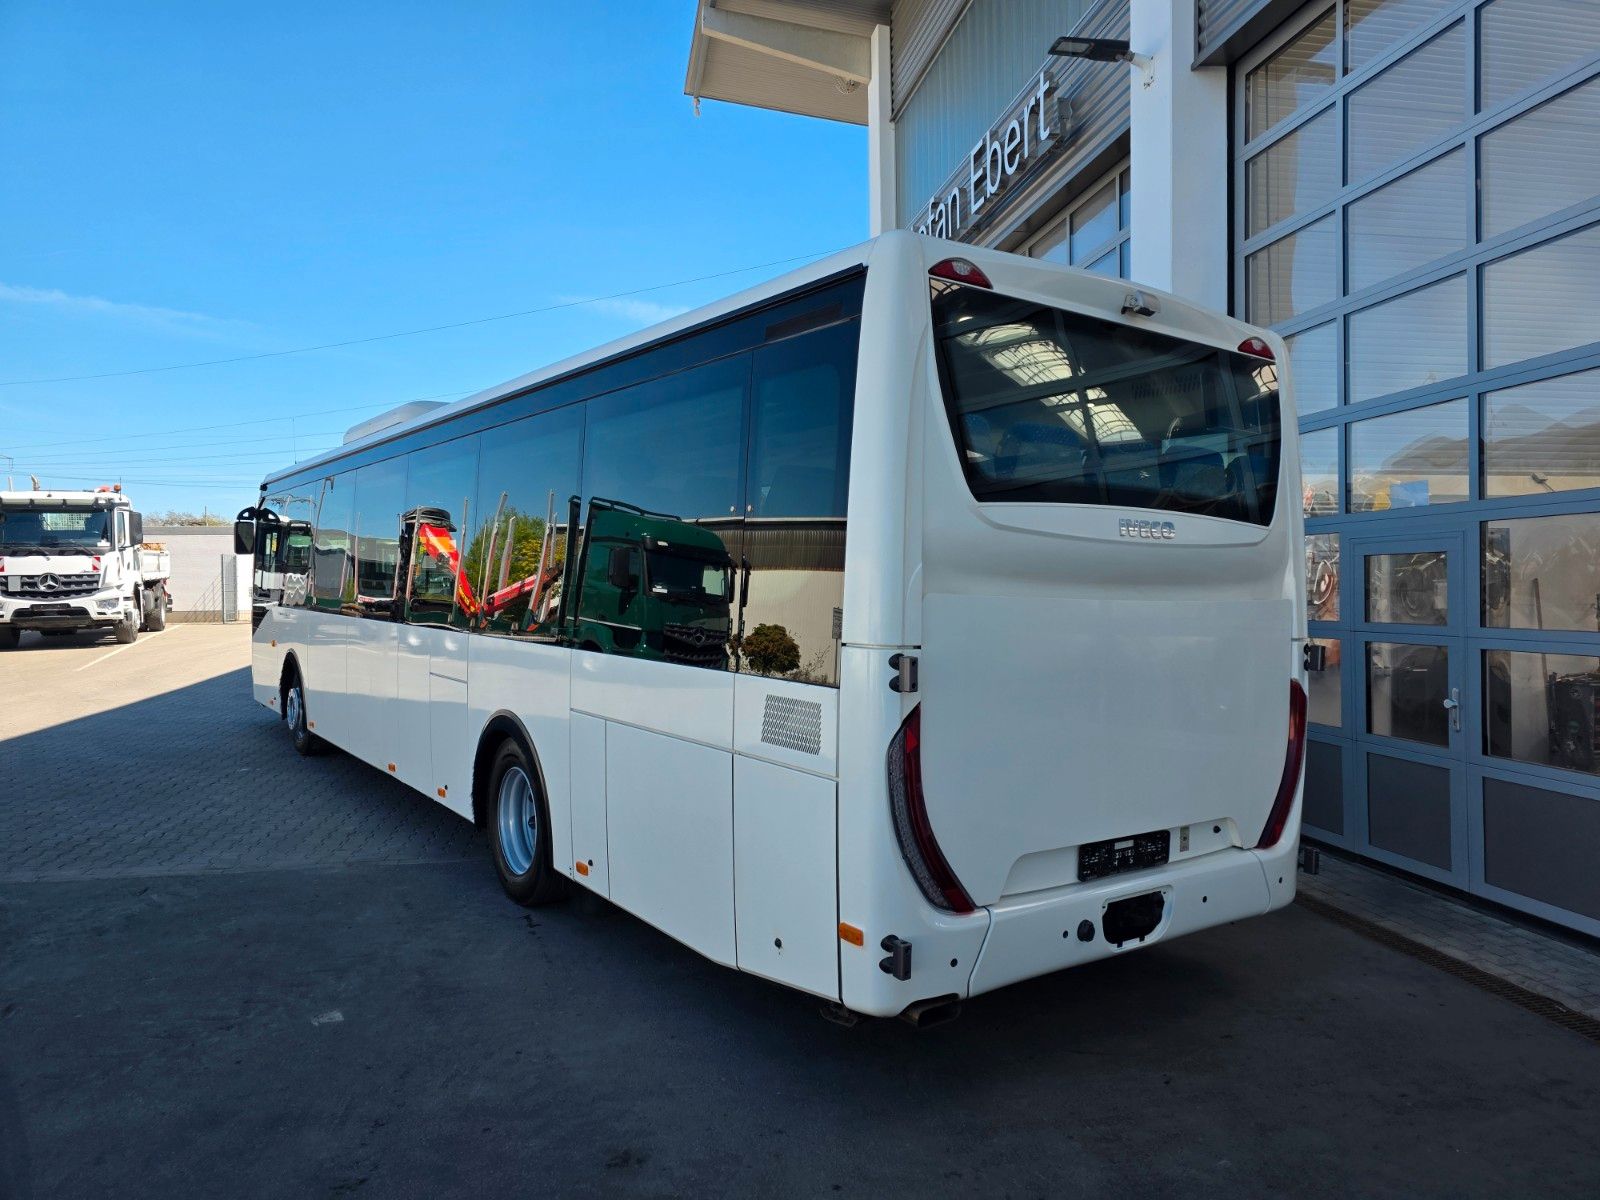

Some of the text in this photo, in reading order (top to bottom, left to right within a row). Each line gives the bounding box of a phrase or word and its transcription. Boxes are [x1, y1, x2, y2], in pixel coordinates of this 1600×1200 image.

[911, 72, 1050, 240] fan Ebert
[1119, 518, 1176, 539] IVECO
